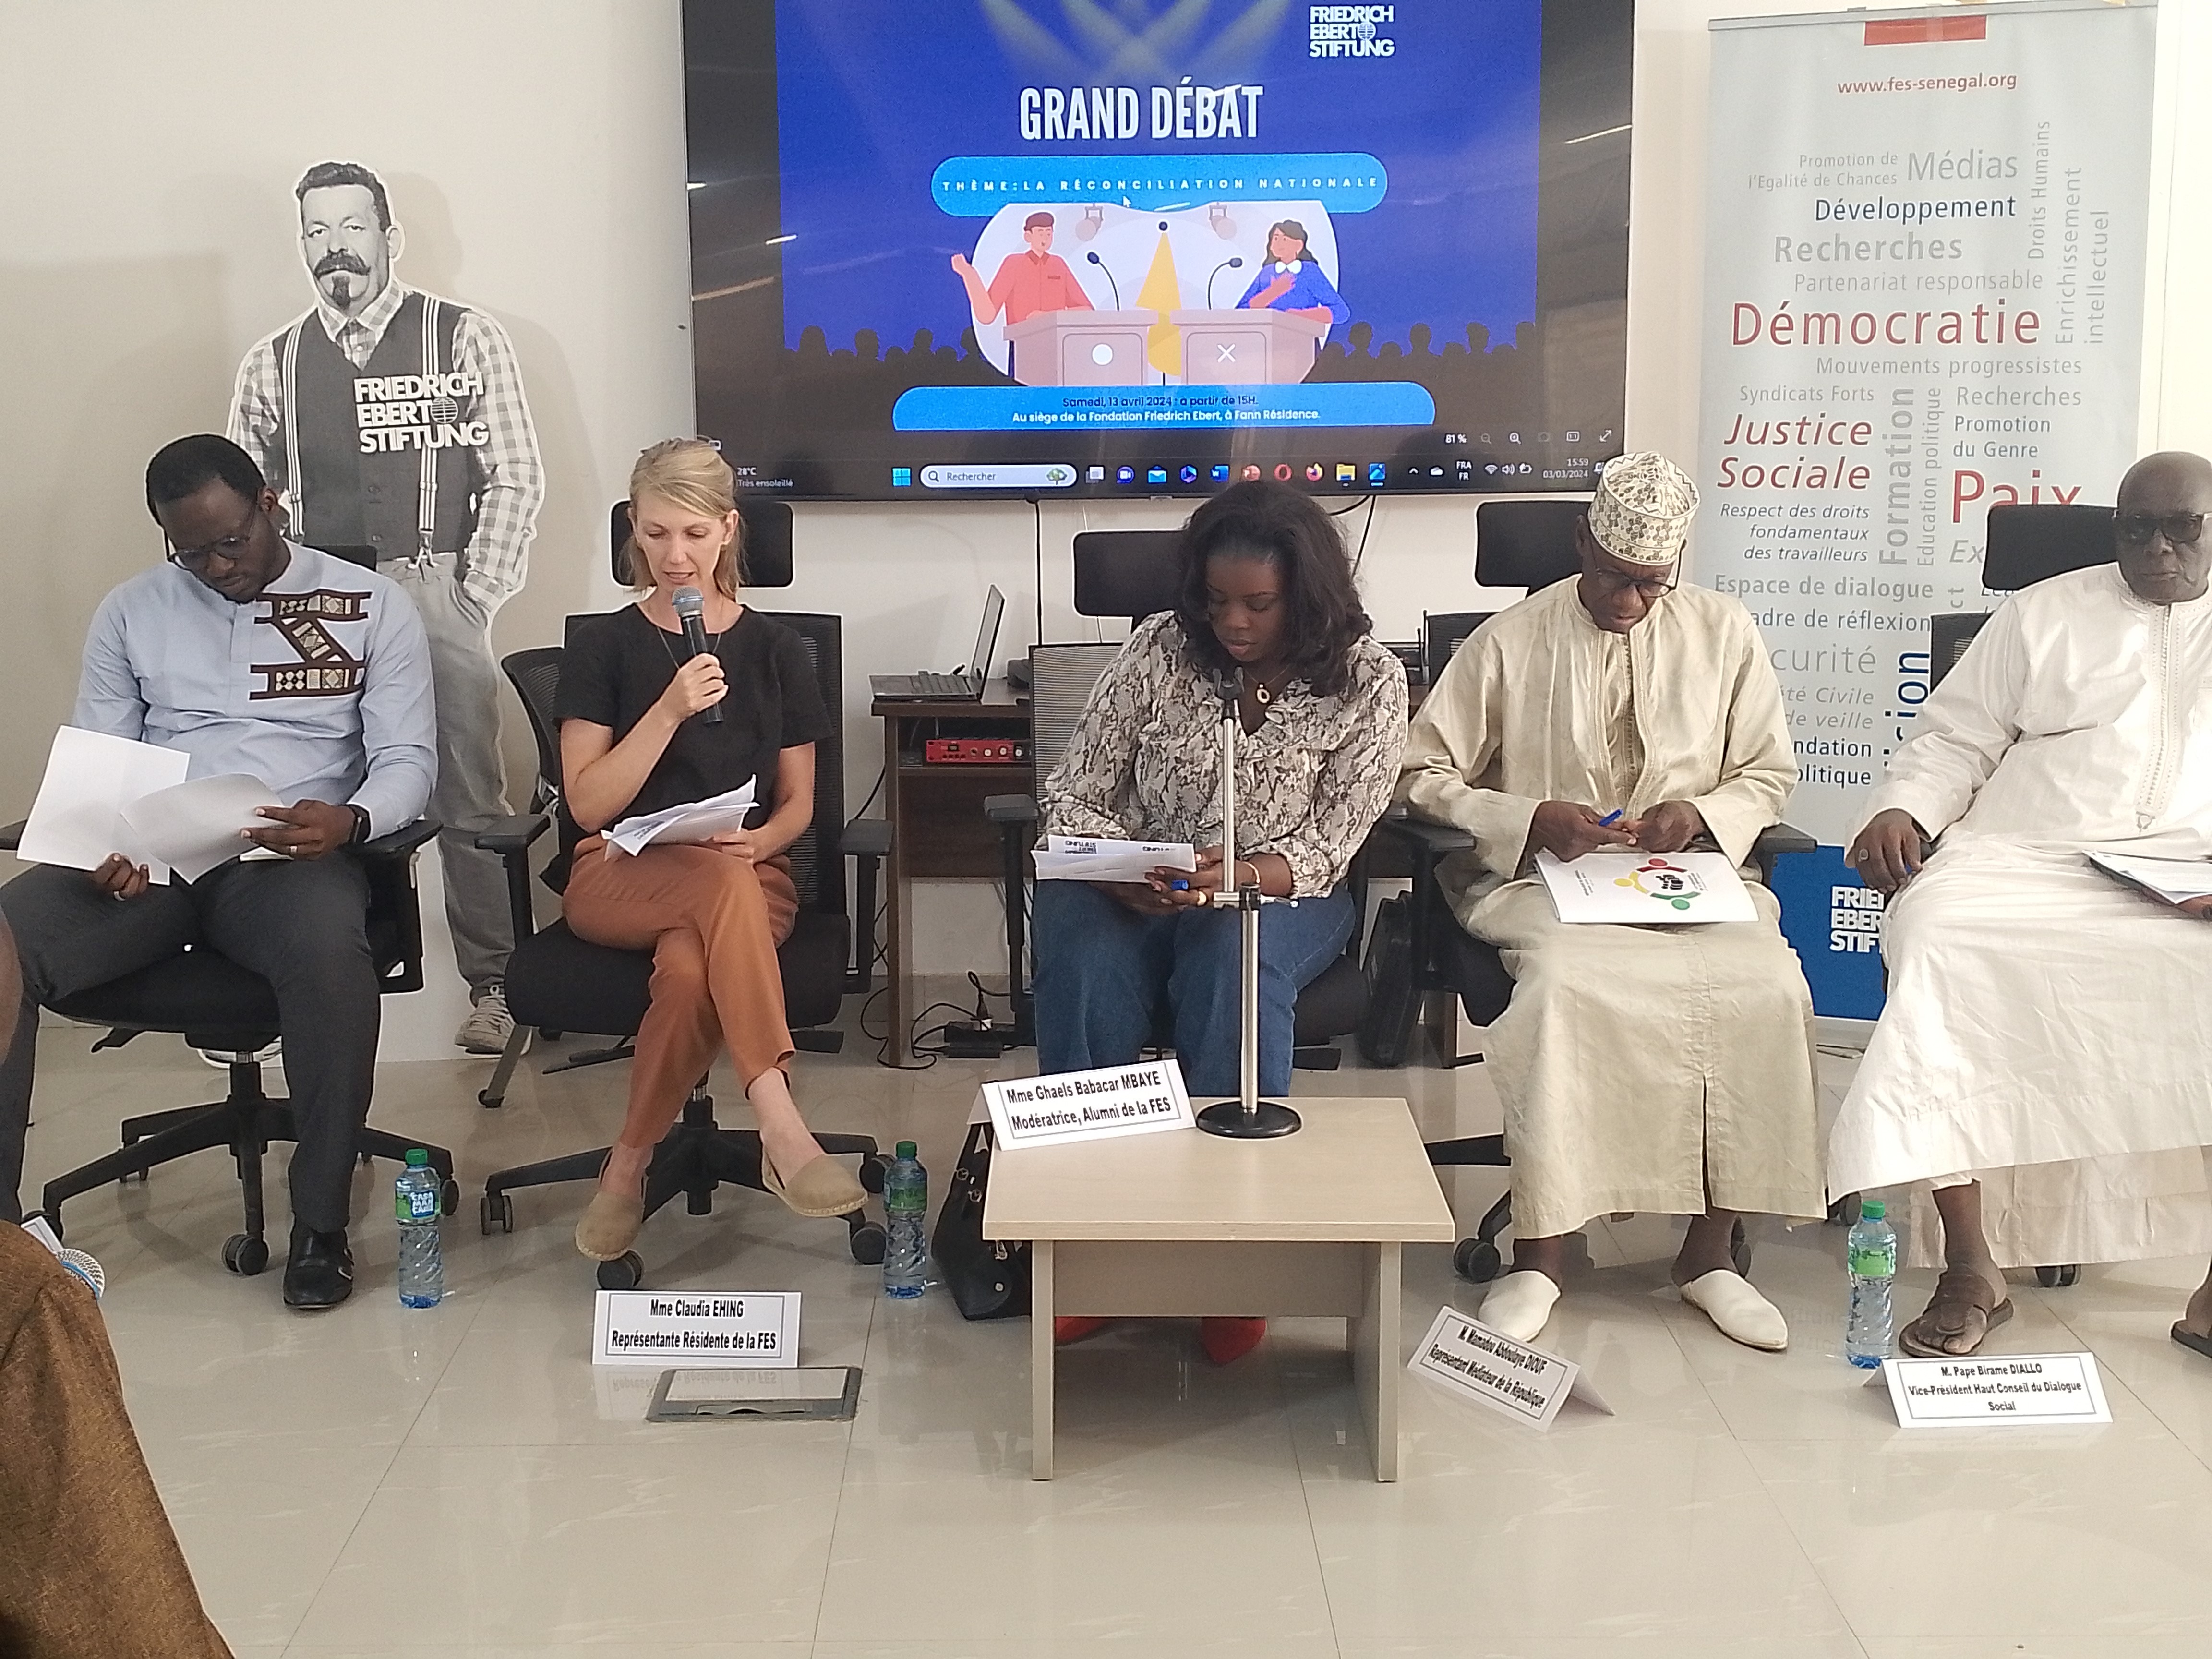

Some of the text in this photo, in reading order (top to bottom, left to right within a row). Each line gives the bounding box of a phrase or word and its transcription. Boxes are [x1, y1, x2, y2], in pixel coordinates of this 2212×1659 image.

[1310, 5, 1394, 22] FRIEDRICH
[1310, 24, 1358, 39] EBERT
[1309, 39, 1395, 57] STIFTUNG
[1837, 73, 2017, 95] www.fes-senegal.org
[1019, 76, 1263, 139] GRAND DÉBAT
[1800, 152, 1898, 168] Promotion de
[1907, 149, 2018, 182] Médias
[1060, 179, 1244, 190] RÉCONCILIATION
[1259, 177, 1377, 189] NATIONALE
[1813, 172, 1831, 187] de
[1836, 171, 1898, 186] Chances
[2028, 120, 2050, 260] Droits Humains
[1815, 195, 2016, 225] Développement
[1775, 232, 1963, 263] Recherches
[2056, 167, 2082, 344] Enrichissement
[1795, 269, 2043, 293] Partenariat responsable
[2084, 209, 2109, 345] intellectuel
[1732, 298, 2040, 347] Démocratie
[1817, 355, 2082, 379] Mouvements progressistes
[354, 372, 484, 402] FRIEDRICH
[1740, 385, 1875, 405] Syndicats Forts
[1957, 386, 2081, 406] Recherches
[1063, 397, 1106, 407] Samedi,
[1108, 397, 1118, 406] 13
[1121, 397, 1144, 406] avril
[1147, 397, 1172, 406] 2024
[1190, 395, 1219, 408] partir
[1221, 395, 1235, 405] de
[356, 400, 433, 428] EBERT
[1012, 409, 1320, 425] Au siège de la Fondation Friedrich Ebert, à Fann Résidence.
[1724, 412, 1872, 446] Justice
[1954, 416, 2051, 433] Promotion
[360, 421, 489, 453] STIFTUNG
[1445, 433, 1467, 443] 81 %
[1953, 441, 2038, 458] du Genre
[737, 467, 757, 475] 28°C
[1456, 461, 1472, 469] FRA
[1567, 458, 1589, 466] 15:59
[756, 479, 793, 487] ensoleillé
[947, 472, 996, 481] Rechercher
[1459, 472, 1469, 481] FR
[1543, 469, 1589, 479] 03/03/2024
[1717, 456, 1871, 490] Sociale
[1879, 387, 1915, 565] Formation
[1917, 387, 1945, 567] Education politique
[1720, 503, 1870, 520] Respect des droits
[1749, 524, 1869, 541] fondamentaux
[1743, 545, 1868, 562] des travailleurs
[1715, 575, 1789, 598] Espace
[1799, 576, 1825, 595] de
[1834, 577, 1933, 603] dialogue
[1751, 607, 1929, 632] adre de réflexion
[1771, 643, 1876, 674] curité
[1816, 687, 1874, 704] Civile
[1816, 712, 1873, 729] veille
[1794, 736, 1871, 757] ndation
[1831, 908, 1883, 931] EBER
[1830, 930, 1882, 953] STIF
[1007, 1070, 1161, 1103] Mme Ghaels Babacar MBAYE
[1011, 1097, 1171, 1130] Modératrice, Alumni de la FES
[650, 1299, 744, 1318] Mme Claudia EHING
[612, 1330, 776, 1351] Représentante Résidente de la FES
[1941, 1363, 2042, 1379] M. Pape Birame DIALLO
[1494, 1374, 1505, 1390] de
[1503, 1377, 1512, 1393] la
[1510, 1381, 1545, 1409] République
[1908, 1381, 2081, 1396] Vice-Président Haut Conseil du Dialogue
[1988, 1401, 2016, 1412] Social
